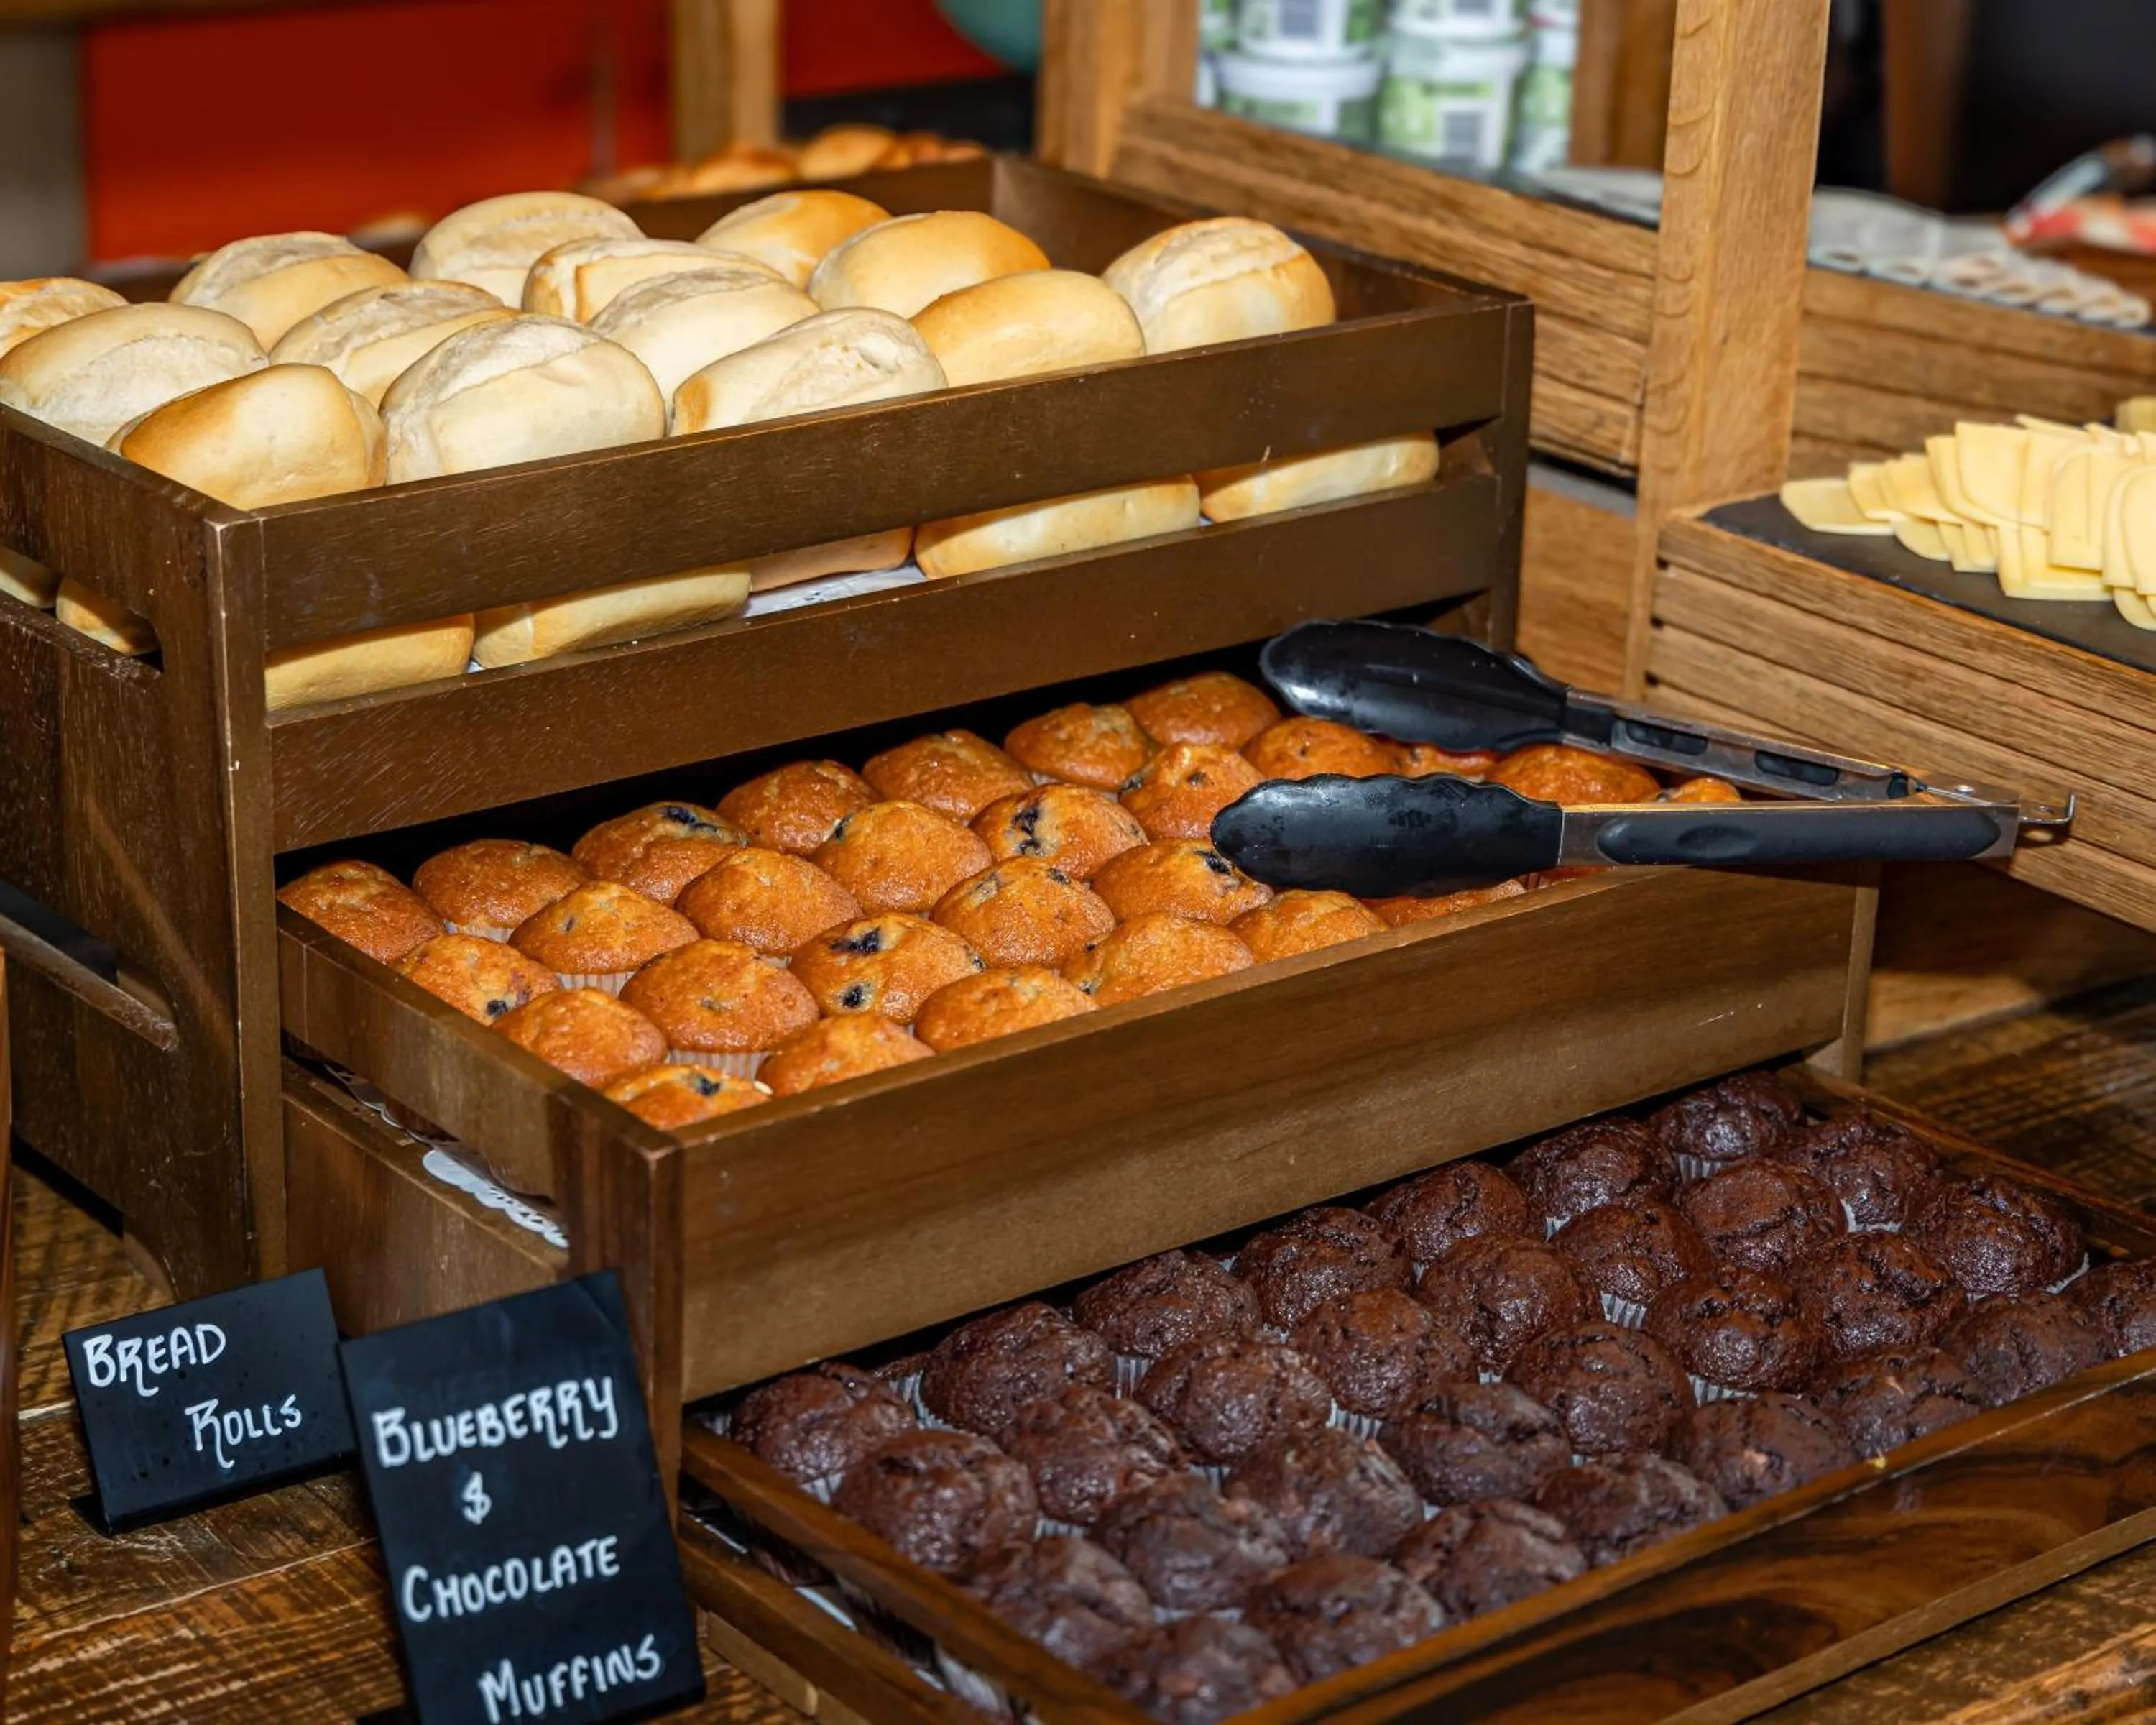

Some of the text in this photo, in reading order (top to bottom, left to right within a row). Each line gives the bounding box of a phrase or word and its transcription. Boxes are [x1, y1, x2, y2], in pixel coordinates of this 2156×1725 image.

[83, 1323, 226, 1397] BREAD
[184, 1394, 302, 1468] ROLLS
[371, 1376, 619, 1468] BLUEBERRY
[403, 1535, 620, 1622] CHOCOLATE
[478, 1633, 661, 1724] MUFFINS
